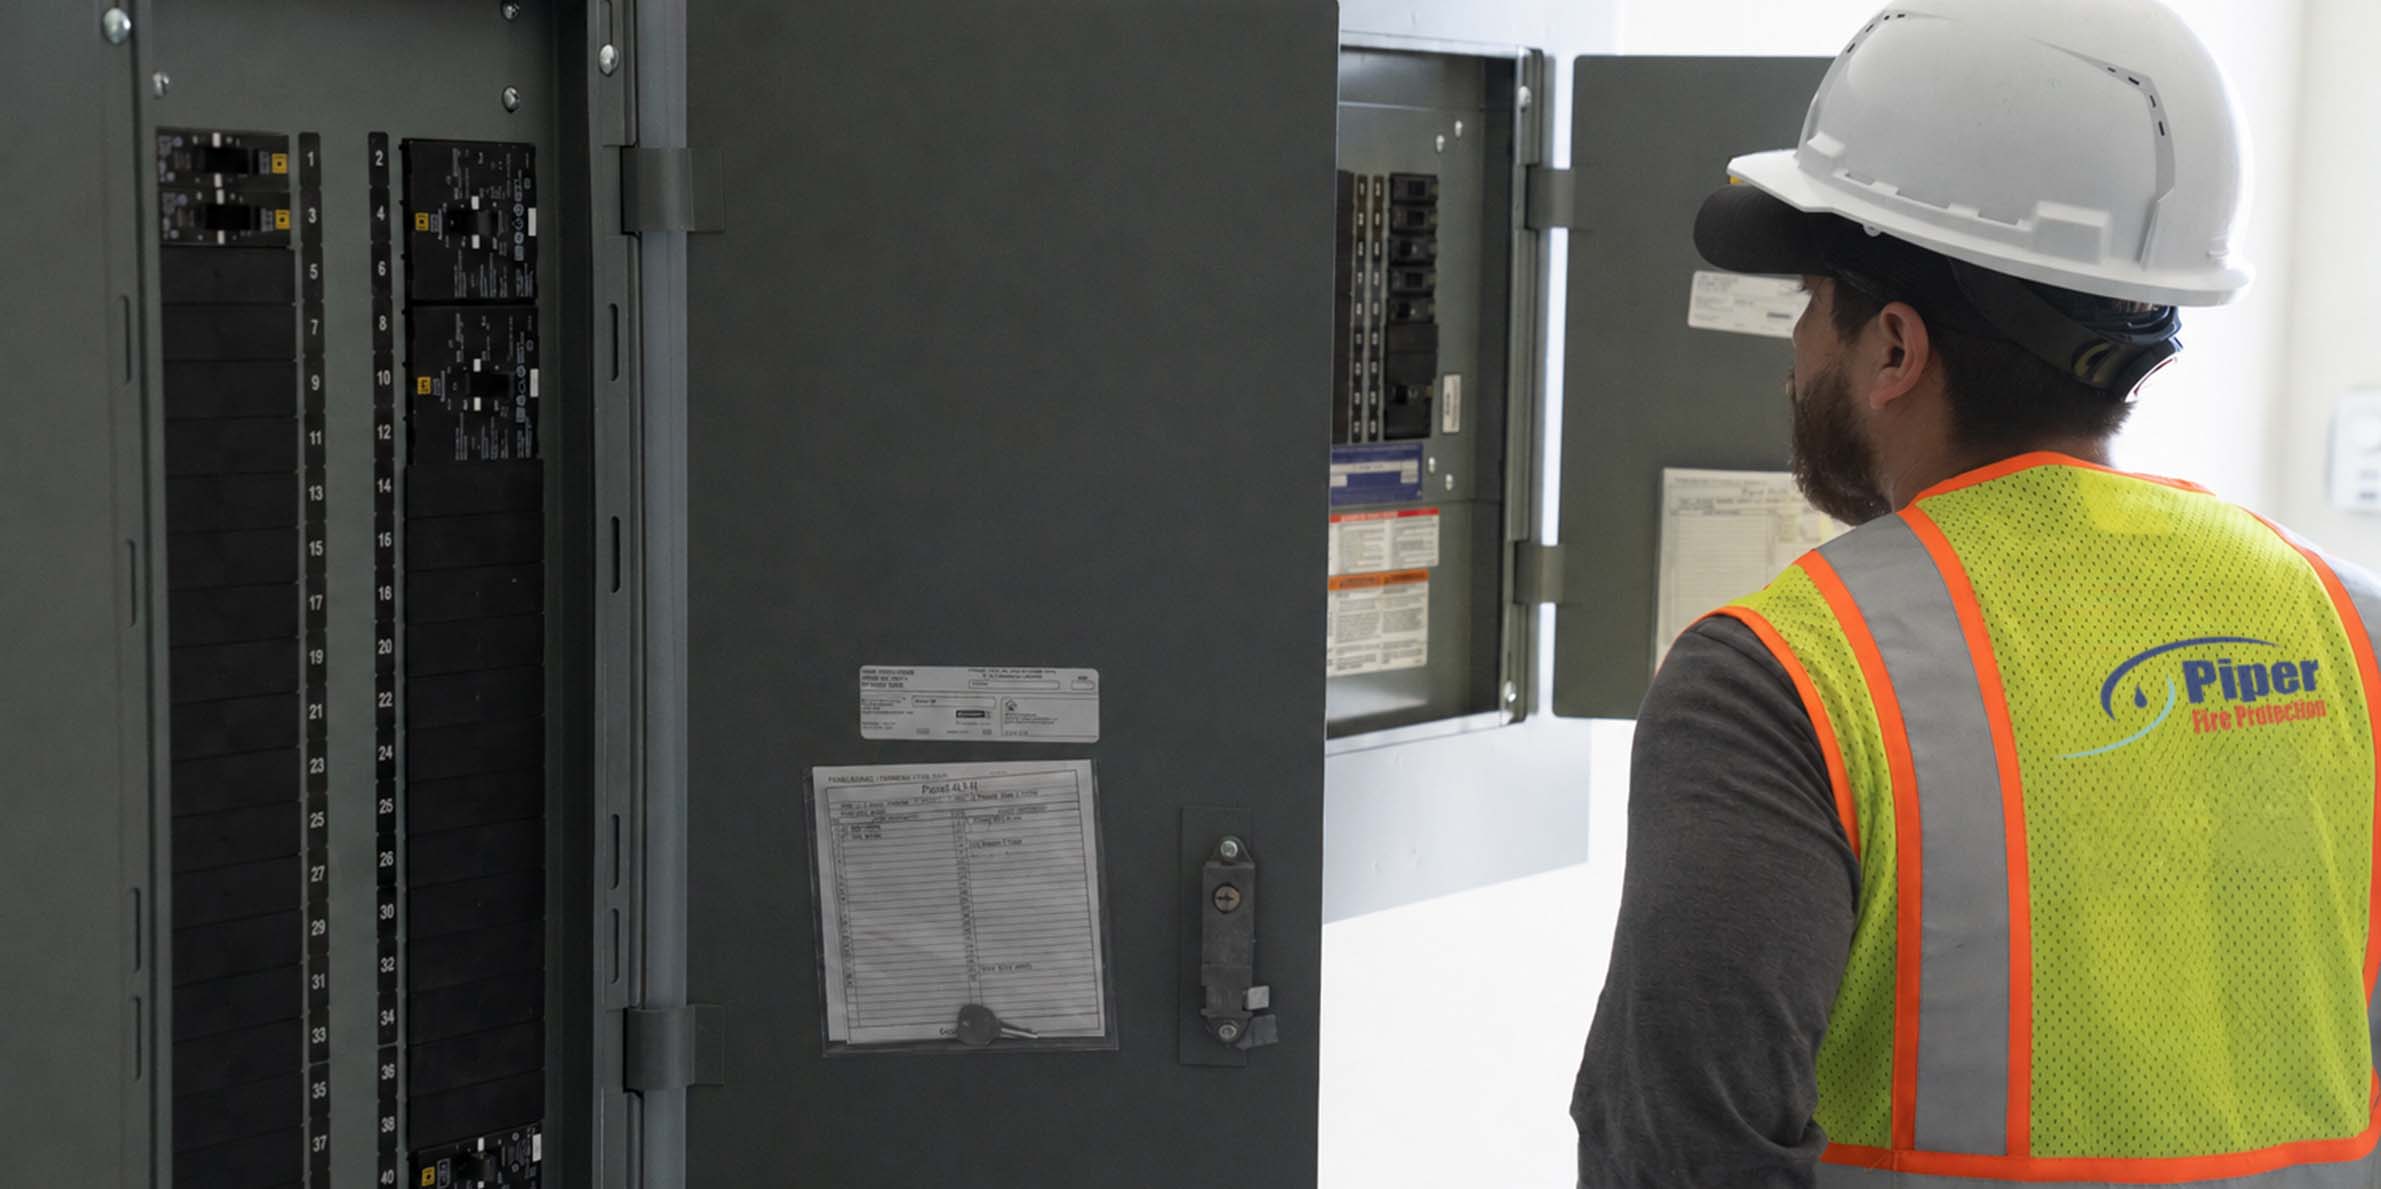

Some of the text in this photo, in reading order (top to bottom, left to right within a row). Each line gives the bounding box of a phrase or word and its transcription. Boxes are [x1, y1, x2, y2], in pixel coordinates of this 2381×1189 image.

[306, 151, 315, 167] 1
[374, 150, 384, 167] 2
[307, 207, 318, 225] 3
[375, 206, 386, 221] 4
[309, 263, 319, 280] 5
[377, 261, 387, 277] 6
[310, 319, 320, 336] 7
[378, 315, 388, 332] 8
[310, 374, 321, 392] 9
[376, 369, 392, 386] 10
[308, 430, 323, 446] 11
[377, 424, 392, 441] 12
[308, 485, 323, 502] 13
[377, 478, 393, 494] 14
[308, 540, 324, 557] 15
[308, 594, 324, 611] 17
[377, 638, 393, 656] 20
[309, 649, 325, 665] 19
[2181, 658, 2319, 704] Piper
[377, 691, 394, 709] 22
[308, 703, 324, 721] 21
[2191, 699, 2327, 734] Fire Protection
[378, 745, 394, 762] 24
[309, 757, 325, 775] 23
[309, 811, 326, 829] 25
[310, 865, 326, 883] 27
[379, 903, 395, 921] 30
[310, 919, 327, 937] 29
[379, 956, 396, 974] 32
[311, 973, 326, 991] 31
[379, 1009, 396, 1027] 34
[311, 1026, 328, 1045] 33
[312, 1081, 328, 1100] 35
[312, 1135, 328, 1153] 37
[380, 1167, 397, 1185] 40
